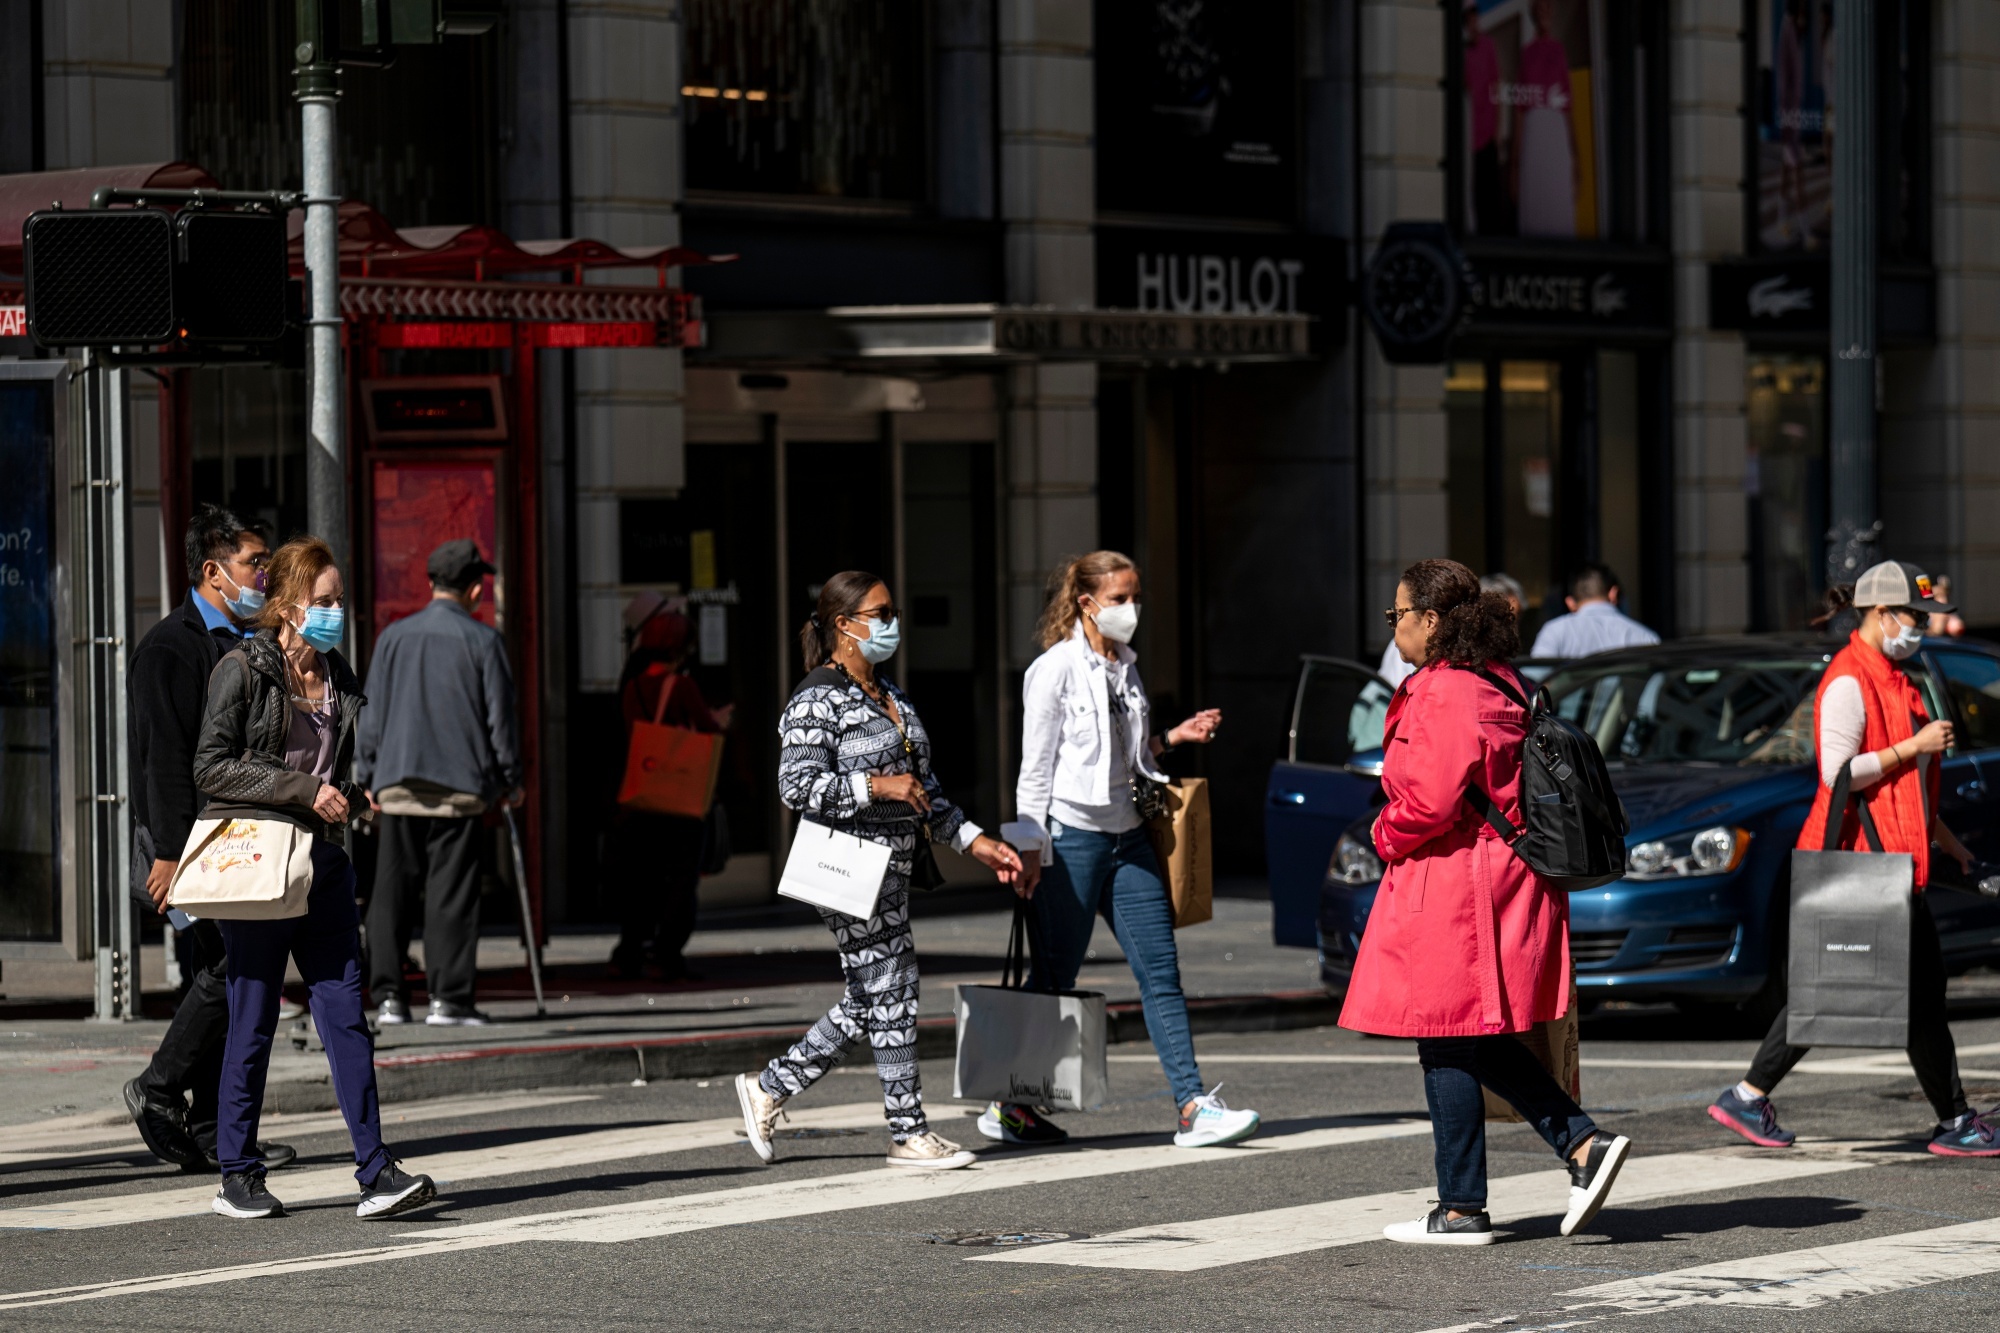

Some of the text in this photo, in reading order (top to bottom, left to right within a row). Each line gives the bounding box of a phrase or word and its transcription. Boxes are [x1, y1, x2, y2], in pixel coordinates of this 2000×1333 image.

[1136, 251, 1304, 315] HUBLOT
[1488, 273, 1588, 311] LACOSTE
[1002, 318, 1293, 352] ONE UNION SQUARE
[818, 861, 851, 878] CHANEL
[1826, 943, 1871, 952] SAINT LAURENT
[1009, 1072, 1072, 1103] Neiman Marcus
